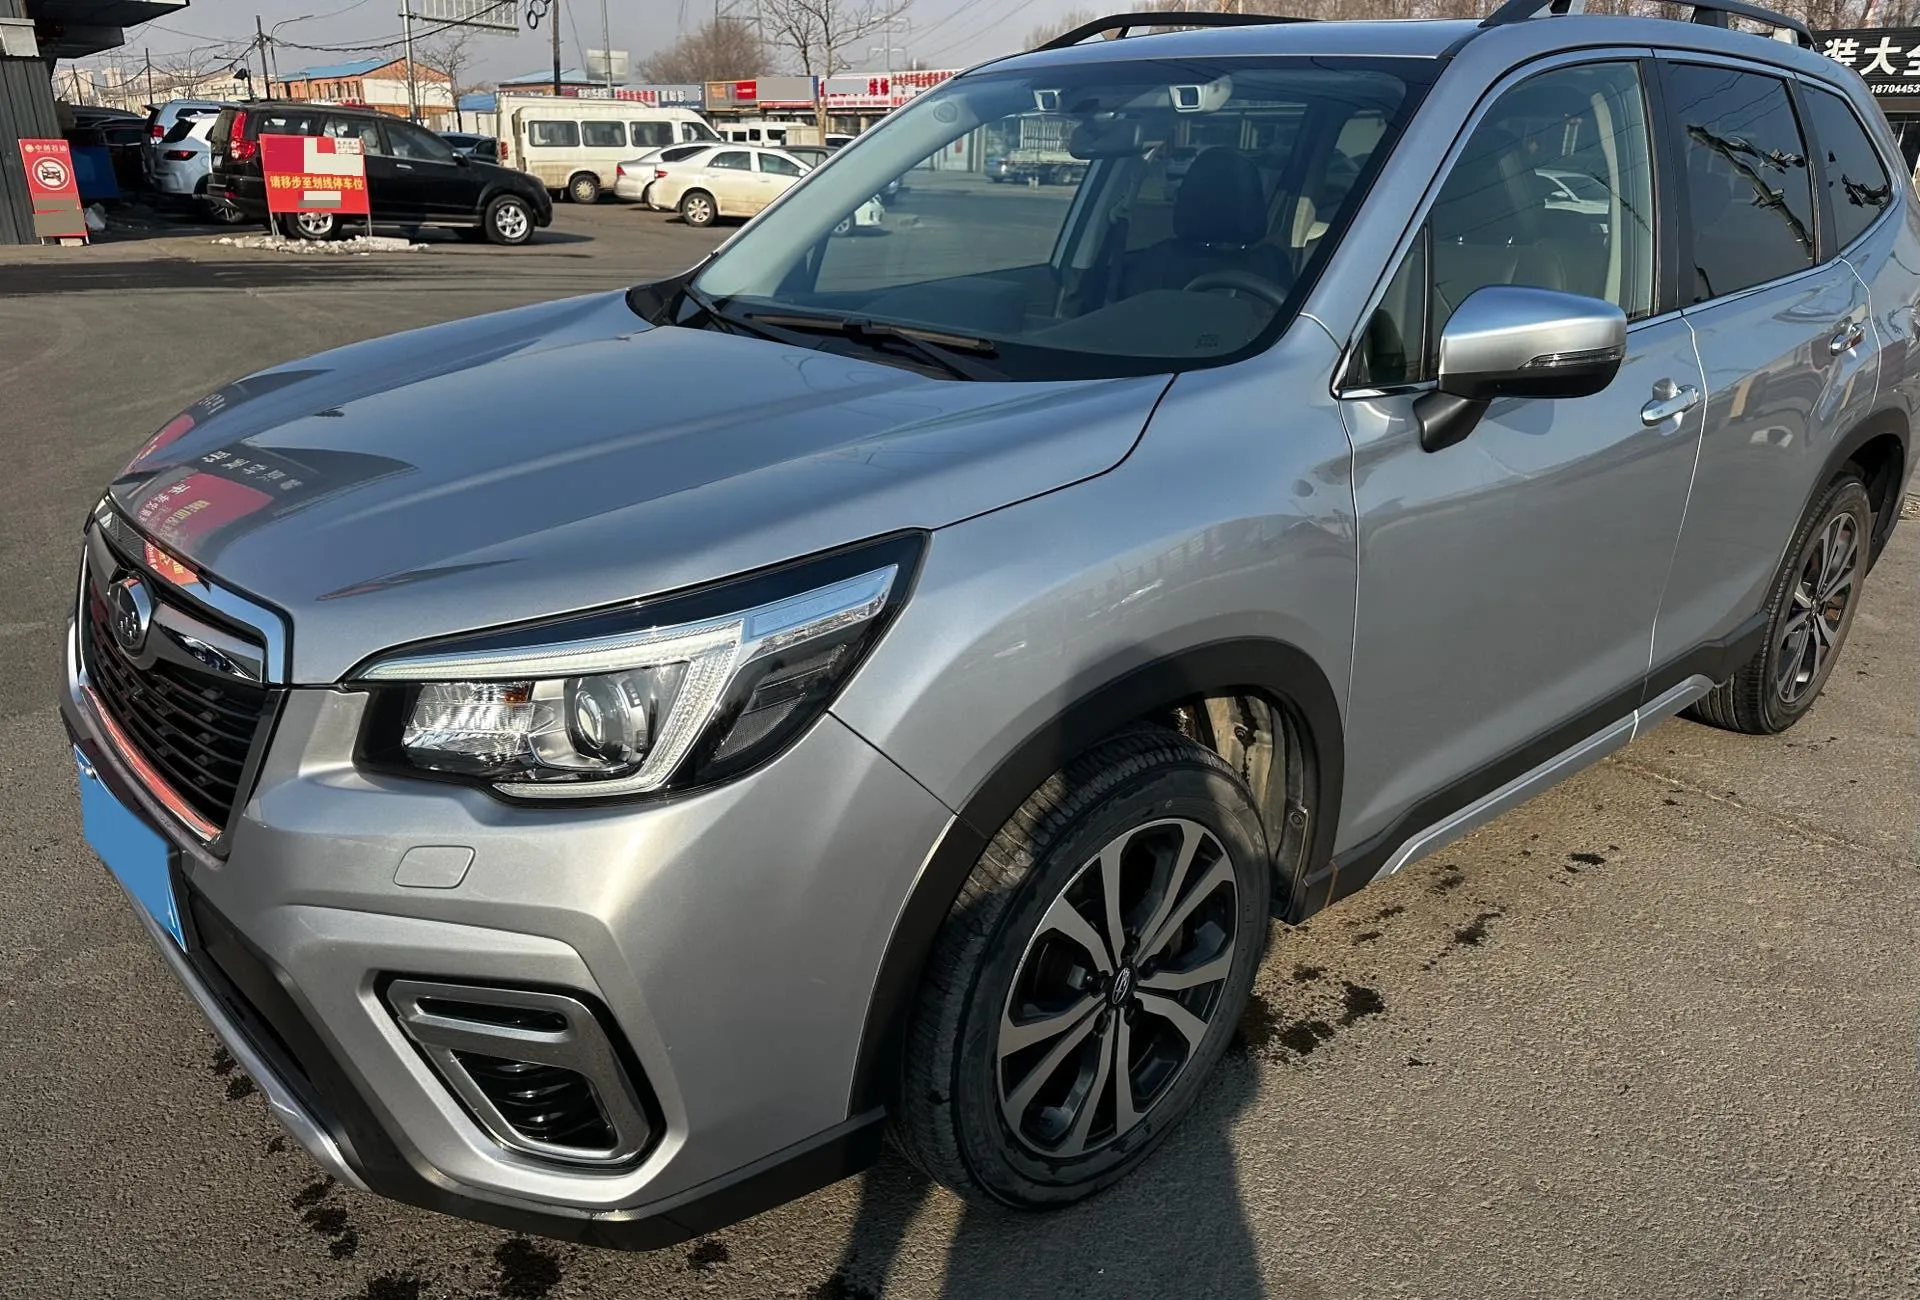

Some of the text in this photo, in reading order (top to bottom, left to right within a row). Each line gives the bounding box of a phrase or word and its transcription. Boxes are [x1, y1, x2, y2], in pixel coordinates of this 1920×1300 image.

[269, 175, 364, 190] 请移步至划线停车位
